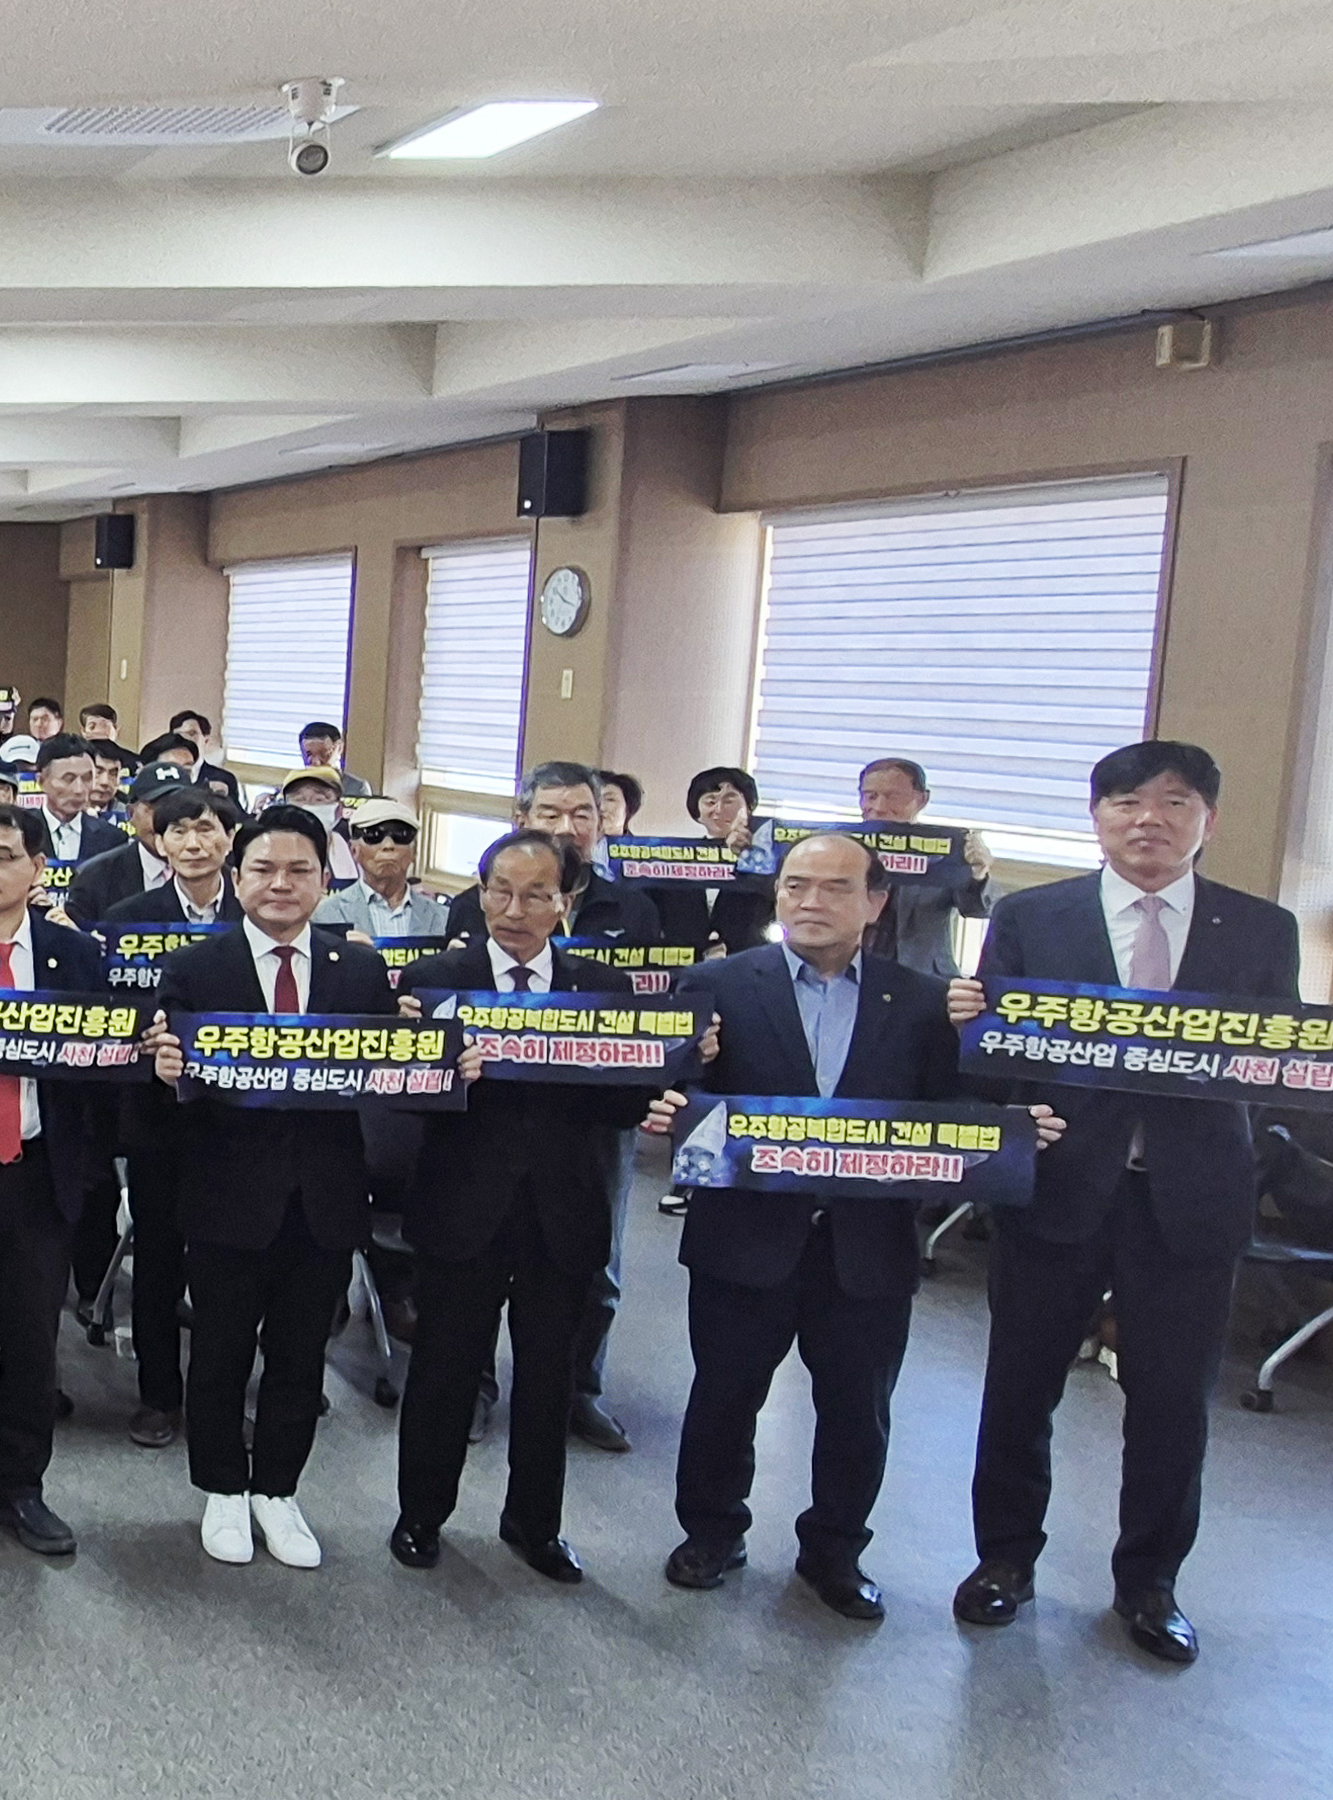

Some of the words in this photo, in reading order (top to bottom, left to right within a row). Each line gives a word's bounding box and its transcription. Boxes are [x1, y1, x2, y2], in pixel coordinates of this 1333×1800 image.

[996, 991, 1333, 1051] 우주항공산업진흥원
[194, 1025, 445, 1062] 우주항공산업진흥원
[477, 1033, 548, 1064] 조속히
[979, 1030, 1118, 1069] 우주항공산업
[1123, 1045, 1221, 1078] 중심도시
[184, 1061, 288, 1091] 우주항공산업
[292, 1068, 362, 1091] 중심도시
[751, 1145, 833, 1174] 조속히
